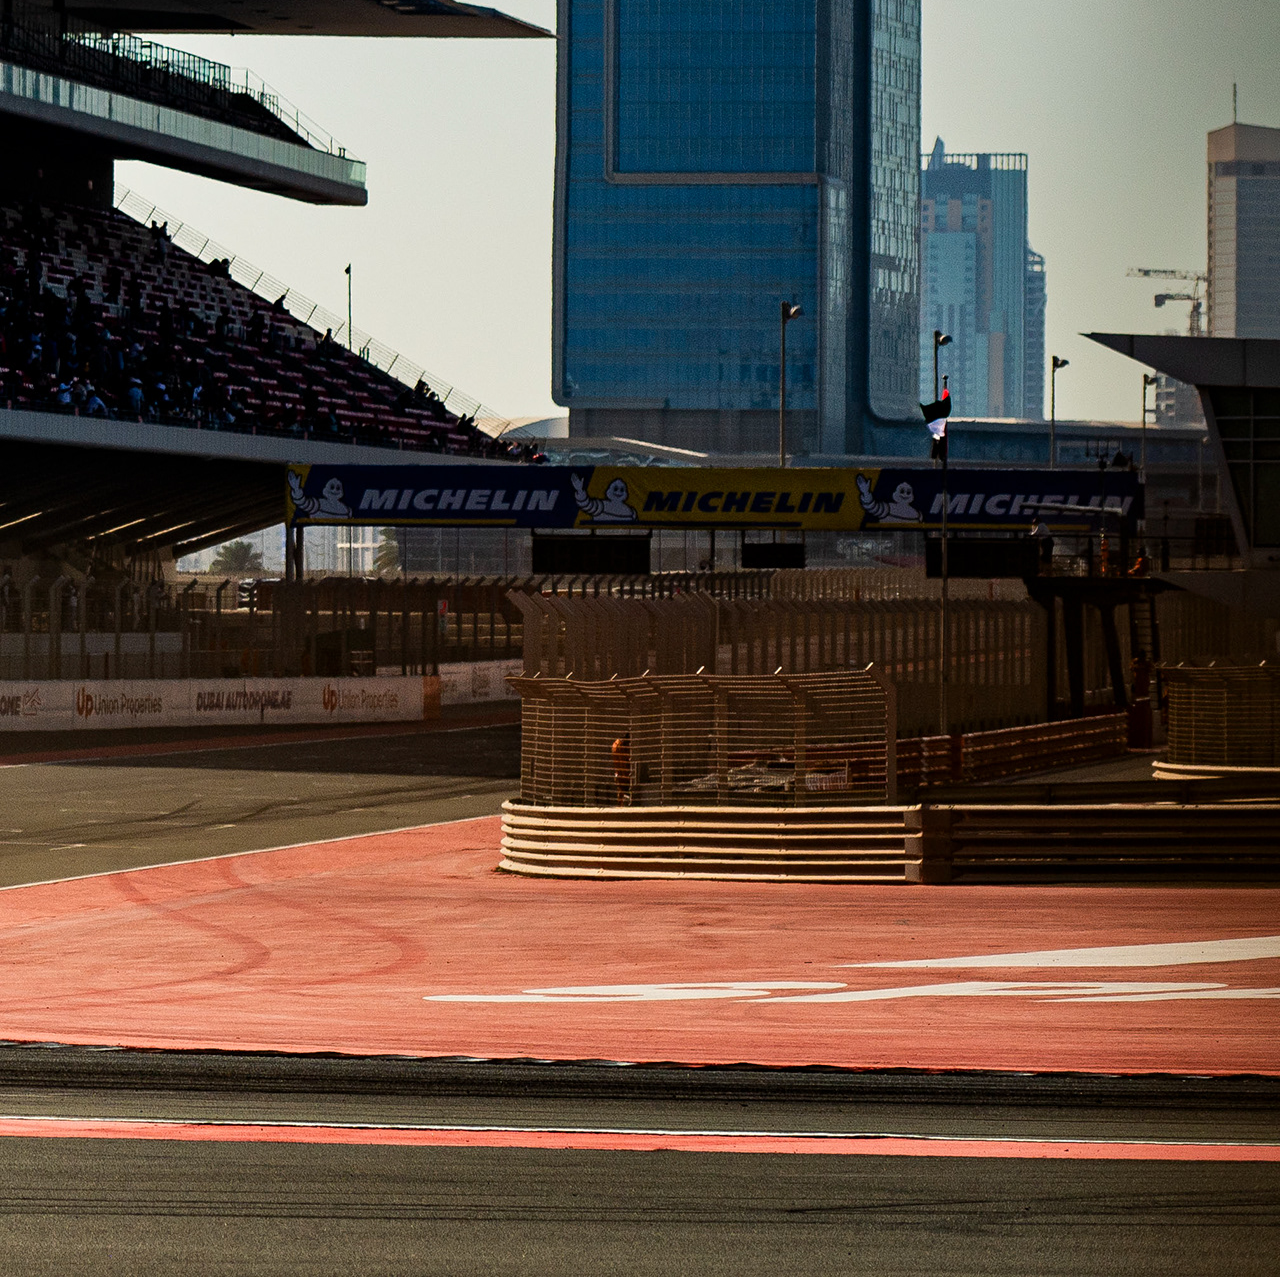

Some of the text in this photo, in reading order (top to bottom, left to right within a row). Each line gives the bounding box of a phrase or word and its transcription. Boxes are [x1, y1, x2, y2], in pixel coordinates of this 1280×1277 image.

[358, 488, 561, 511] MICHELIN
[643, 490, 844, 514] MICHELIN
[95, 694, 119, 716] Union
[121, 693, 162, 718] Properties
